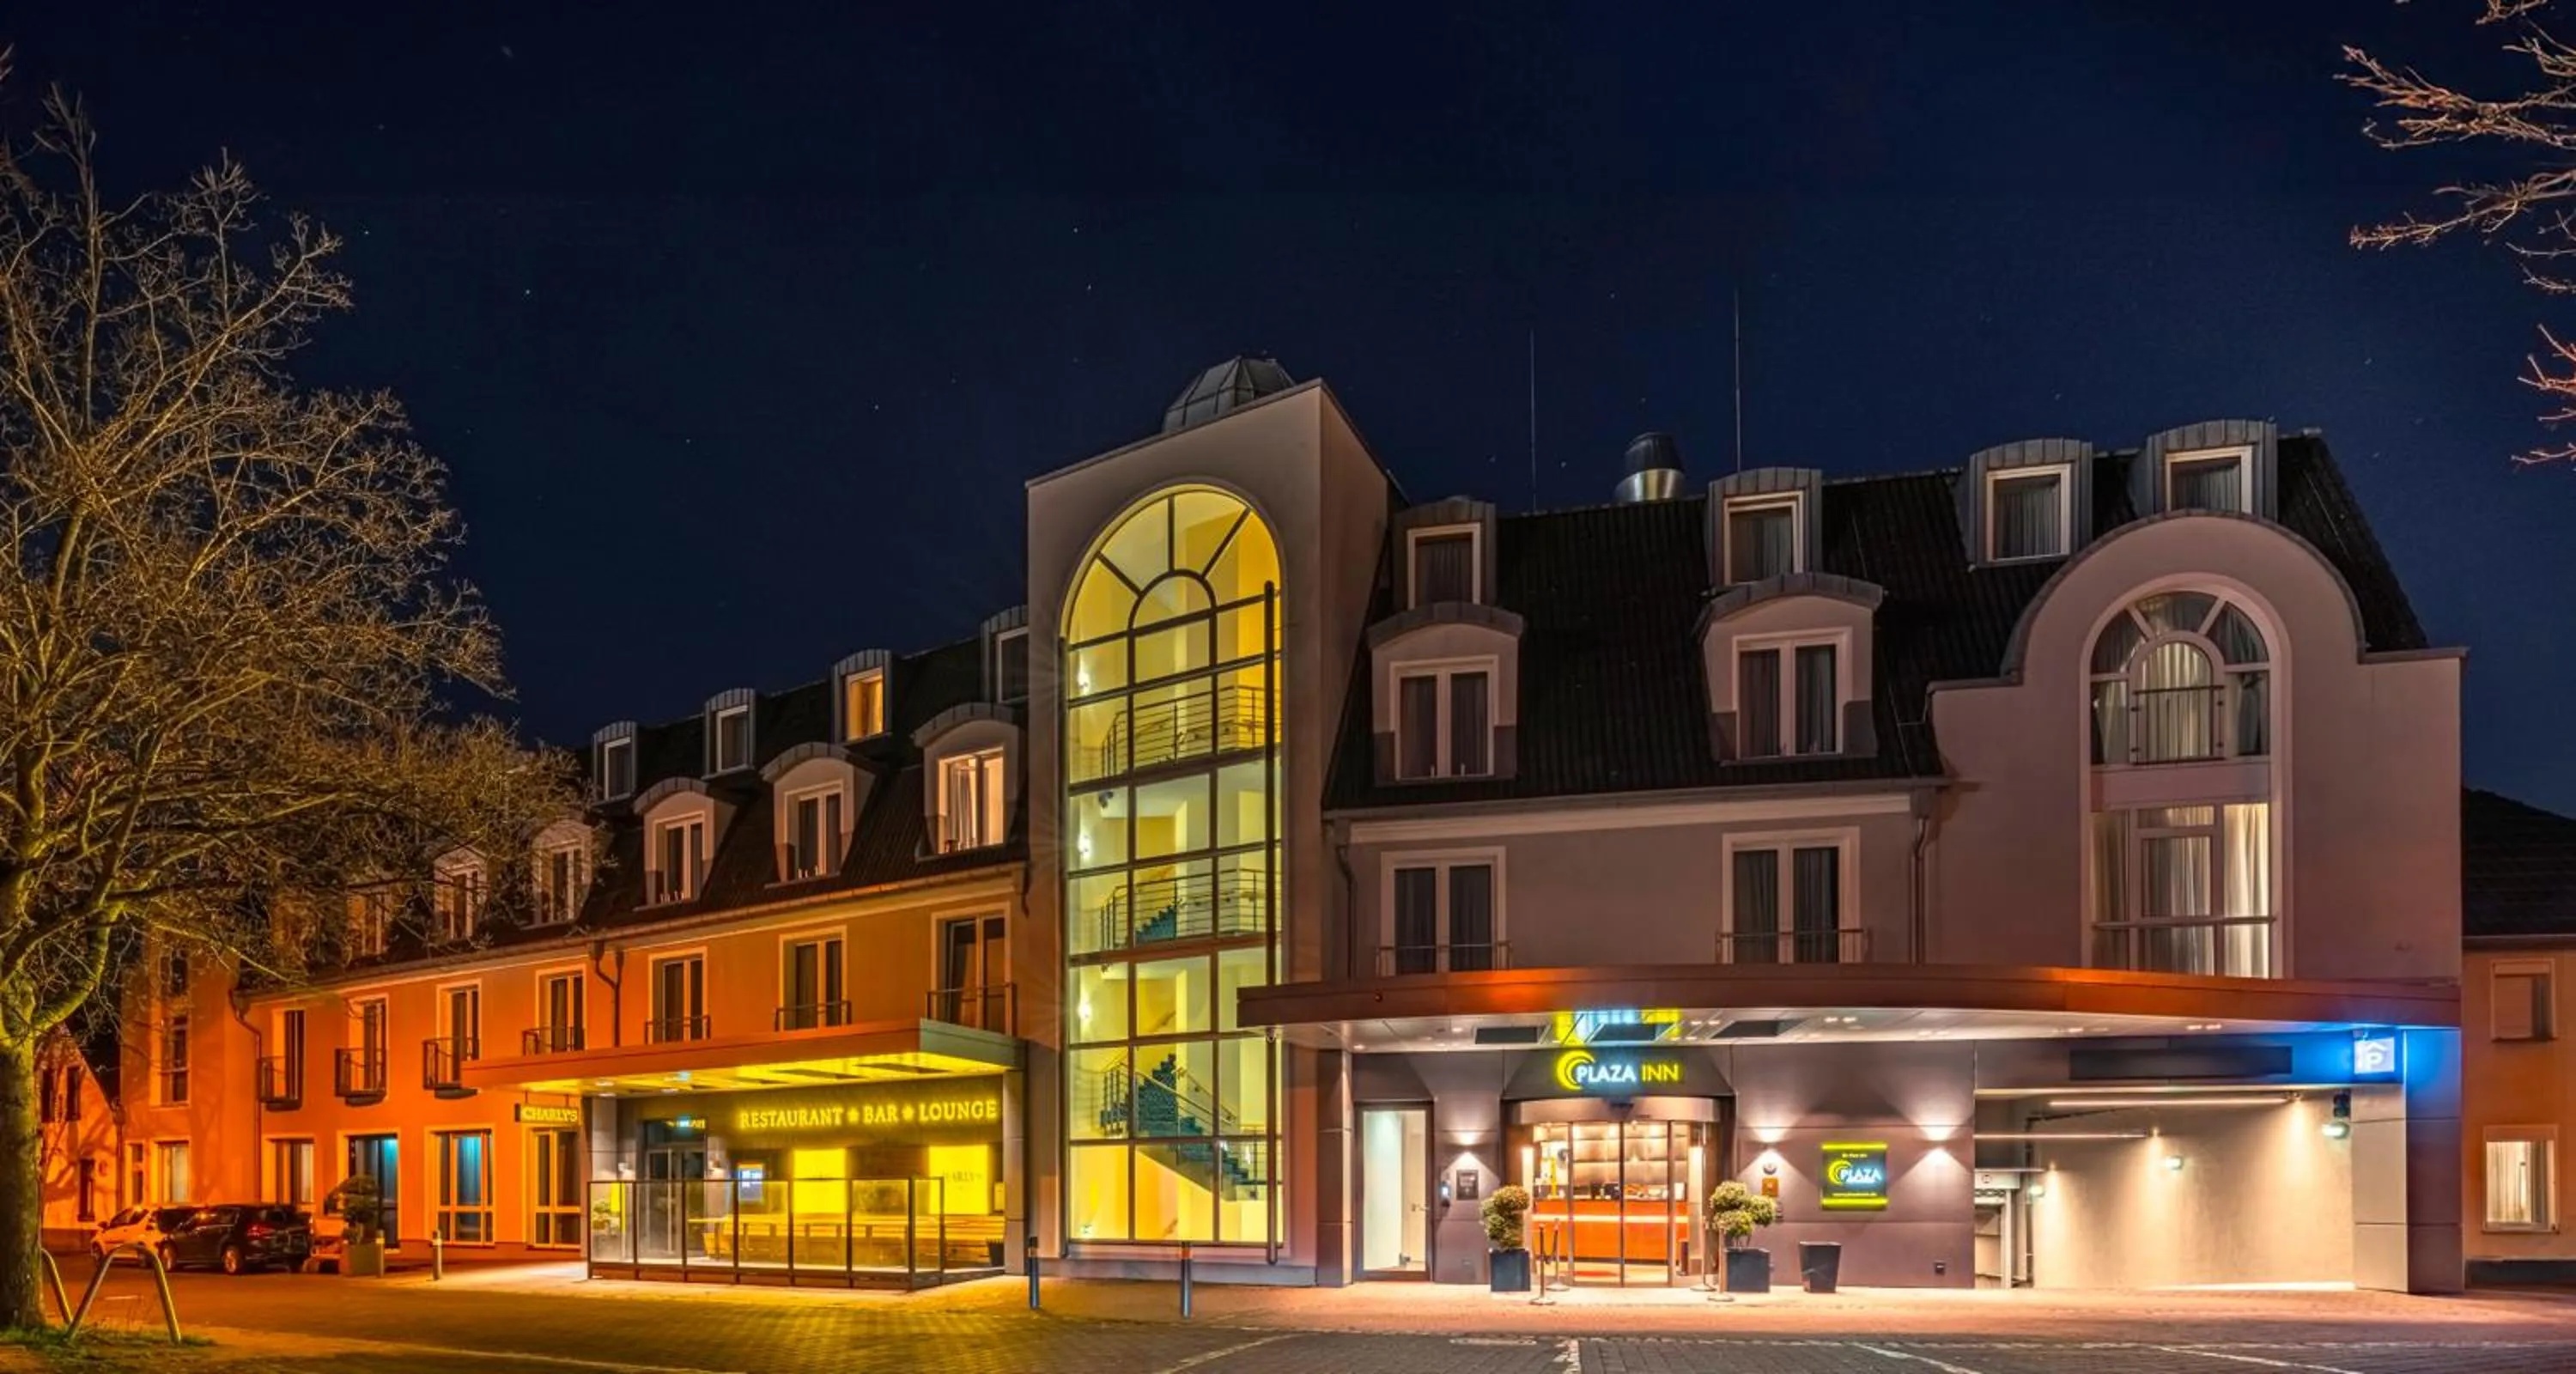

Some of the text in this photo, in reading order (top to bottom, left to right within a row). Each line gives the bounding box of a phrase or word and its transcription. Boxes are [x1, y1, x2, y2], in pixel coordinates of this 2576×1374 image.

[2365, 1052, 2384, 1070] P
[1576, 1063, 1680, 1083] PLAZA INN
[739, 1099, 997, 1129] RESTAURANT BAR LOUNGE
[1840, 1167, 1883, 1182] PLAZA
